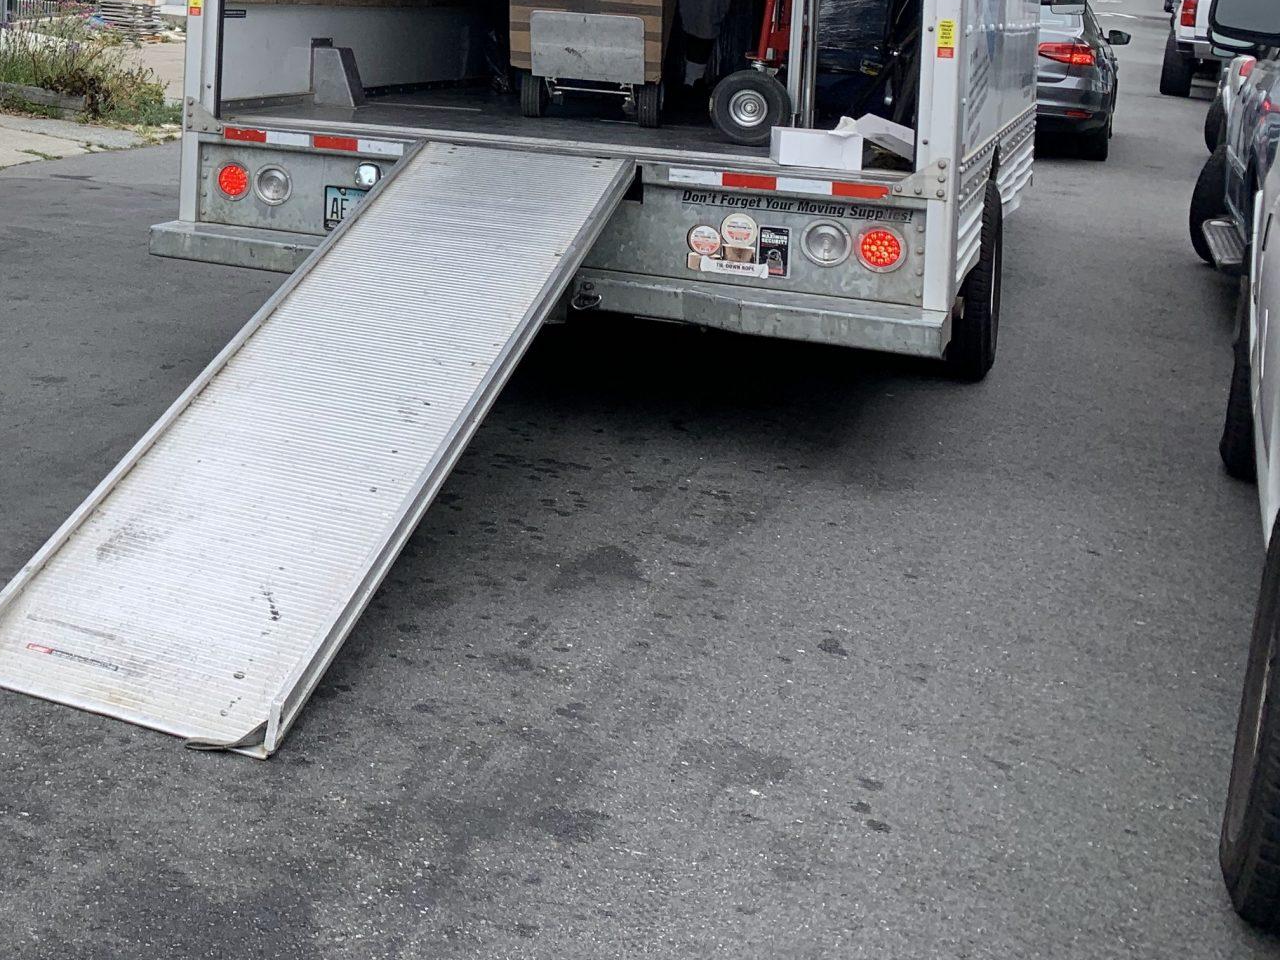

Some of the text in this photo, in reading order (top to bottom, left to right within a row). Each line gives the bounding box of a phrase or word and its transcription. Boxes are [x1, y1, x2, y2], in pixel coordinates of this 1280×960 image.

[682, 190, 717, 204] Don't
[720, 193, 762, 209] Forget
[765, 198, 794, 211] Your
[797, 201, 845, 217] Moving
